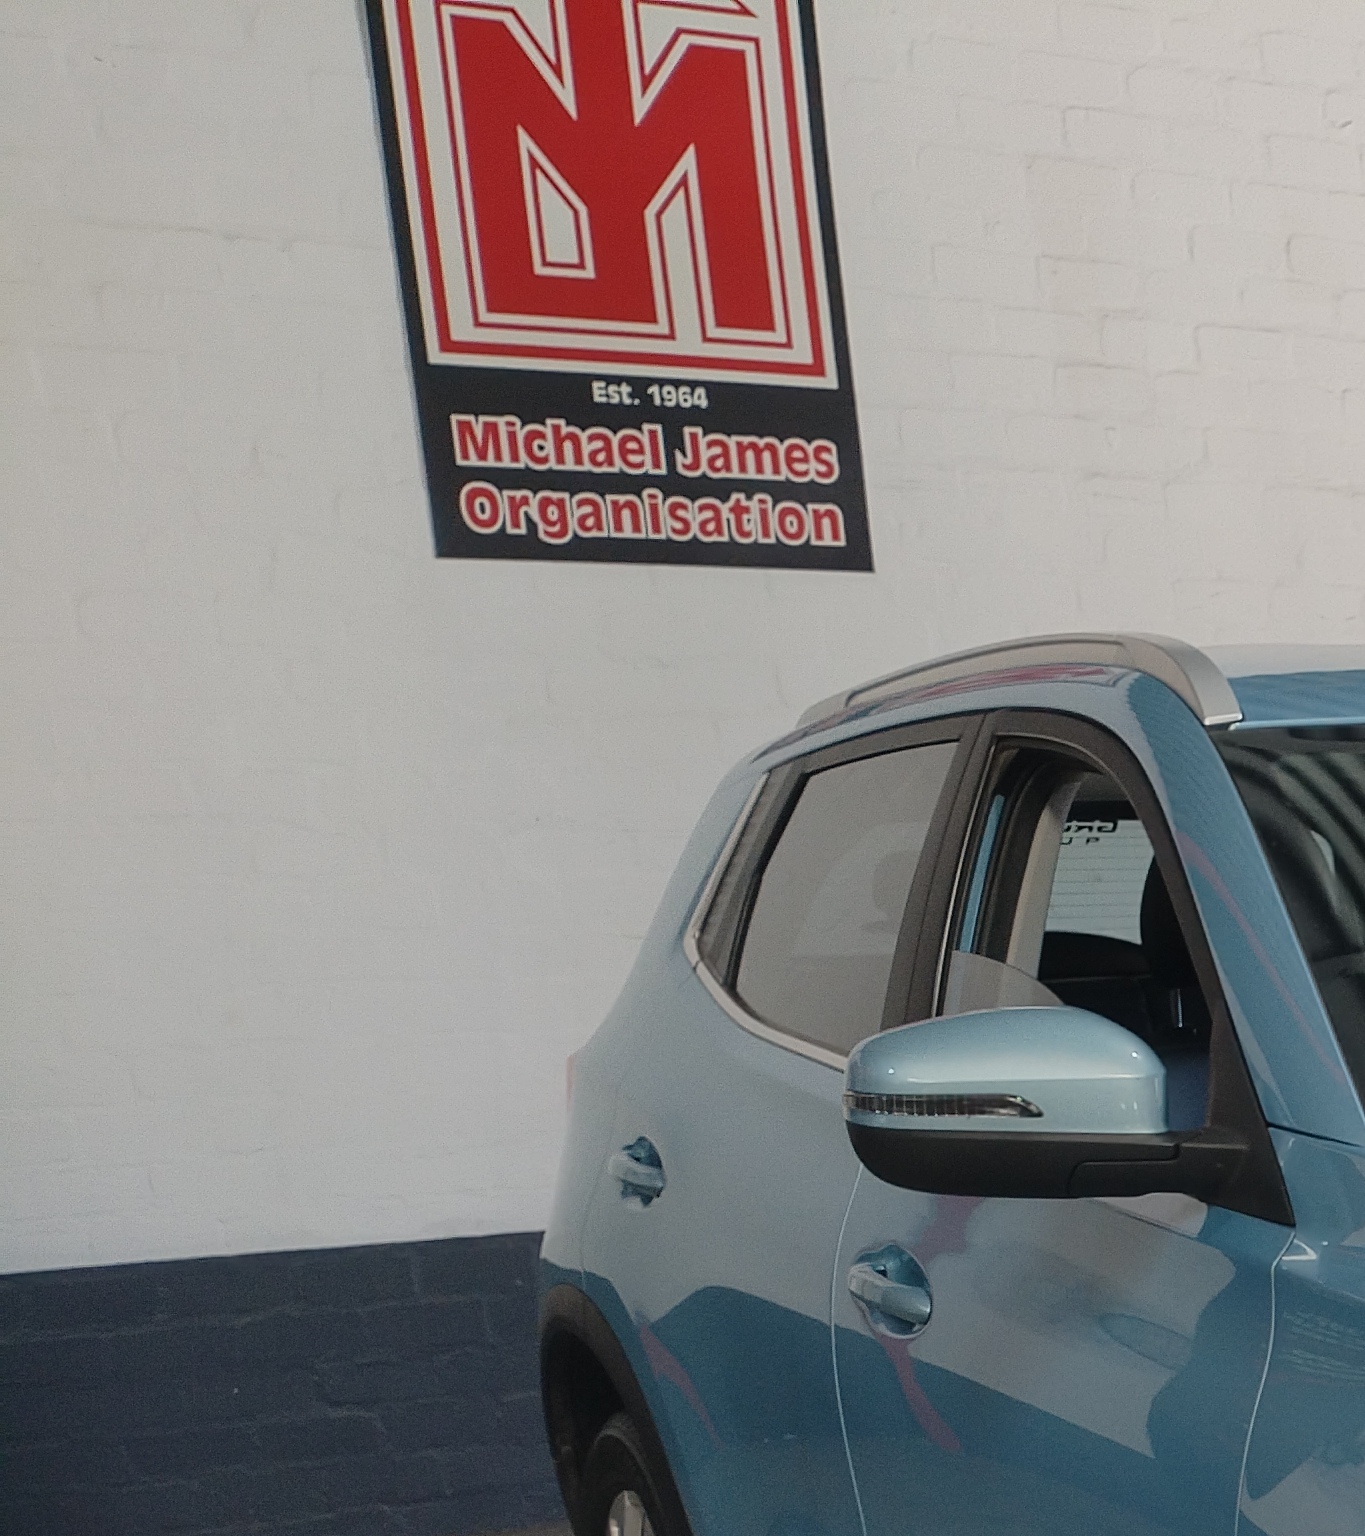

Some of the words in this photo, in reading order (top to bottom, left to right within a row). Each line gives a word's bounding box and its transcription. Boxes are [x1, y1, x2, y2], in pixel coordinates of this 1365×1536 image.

[592, 380, 640, 406] Est.
[647, 384, 708, 409] 1964
[450, 413, 667, 475] Michael
[675, 426, 839, 484] James
[459, 480, 847, 547] Organisation
